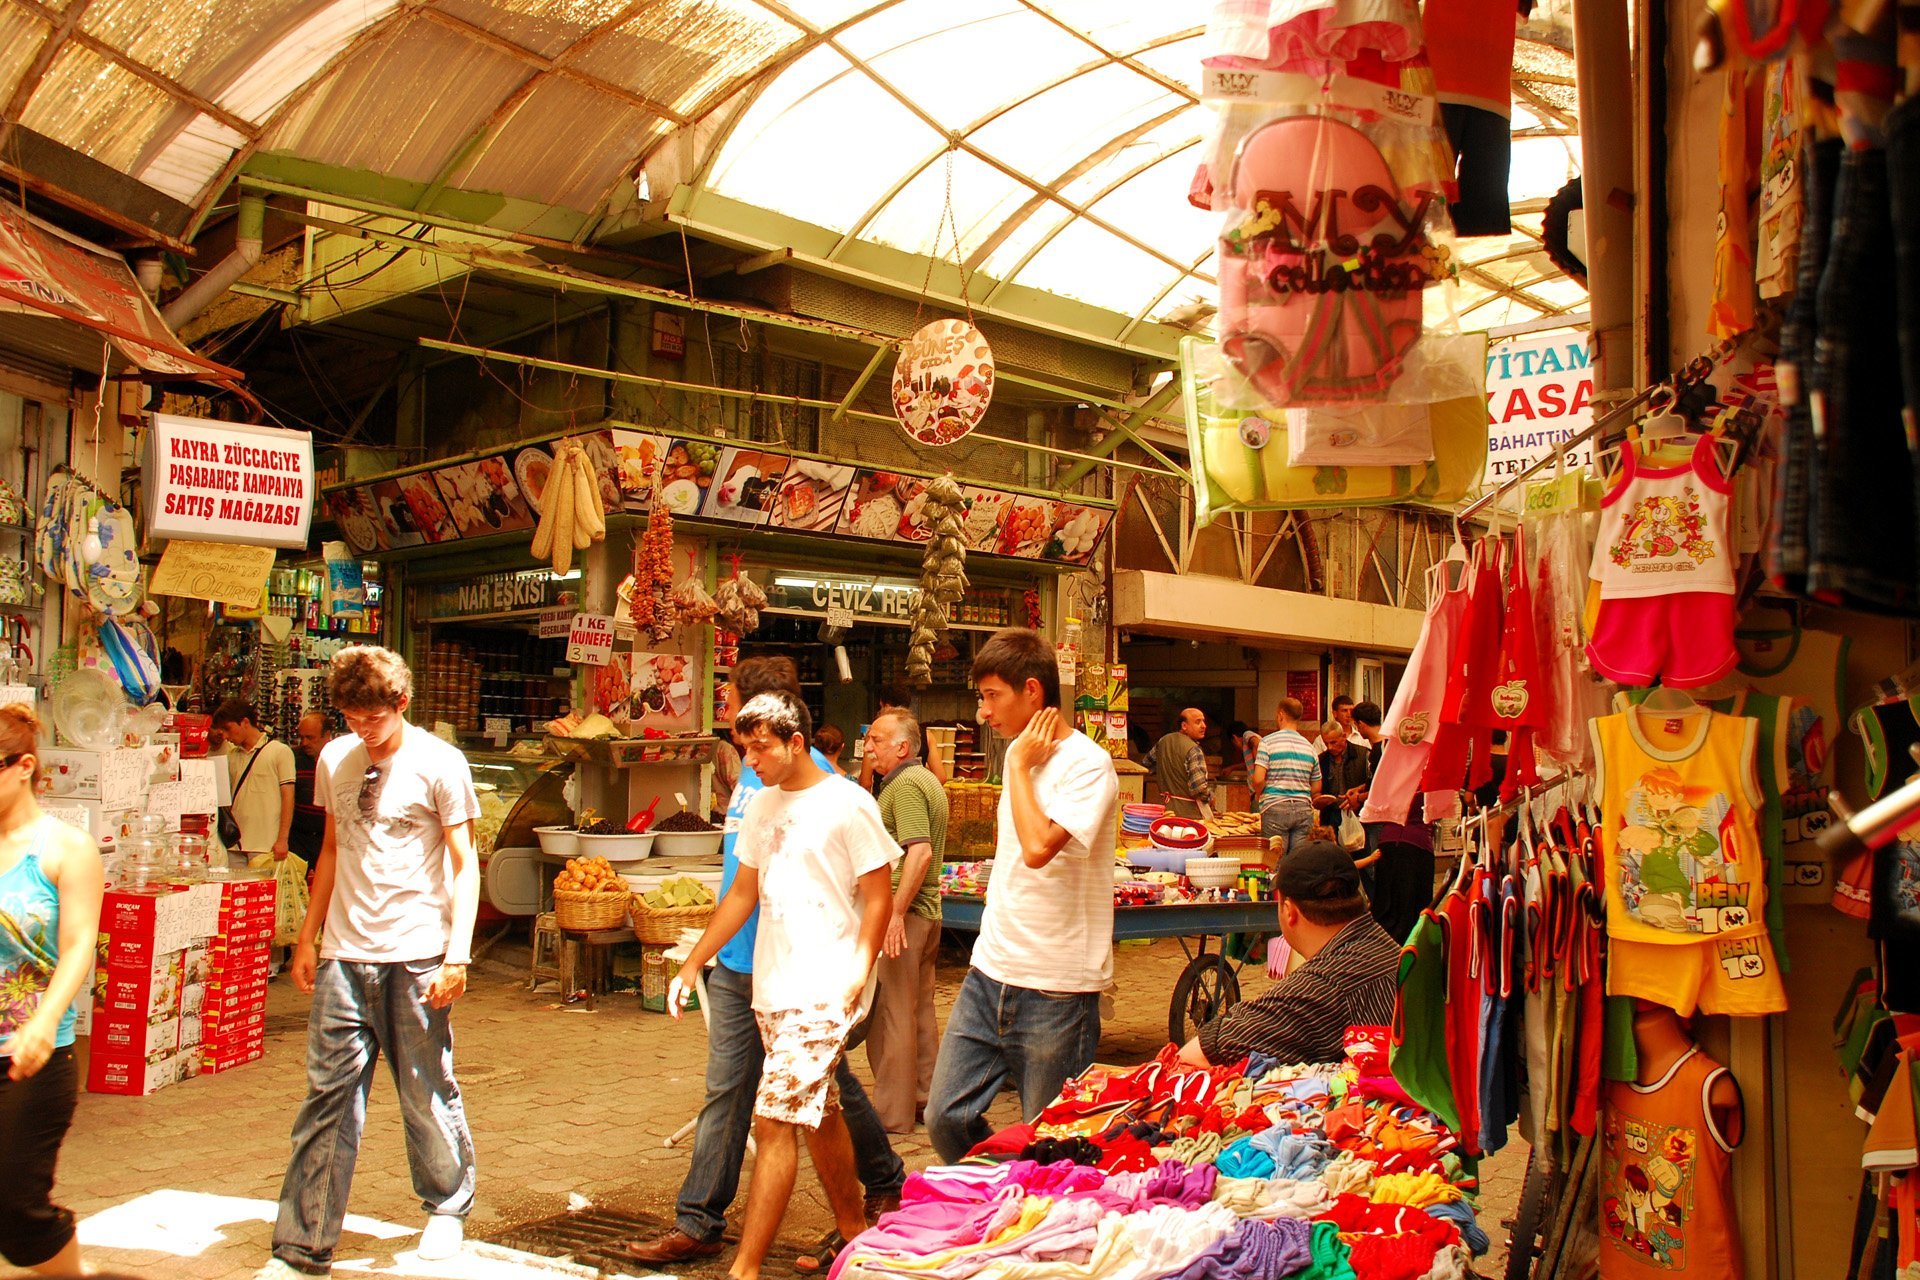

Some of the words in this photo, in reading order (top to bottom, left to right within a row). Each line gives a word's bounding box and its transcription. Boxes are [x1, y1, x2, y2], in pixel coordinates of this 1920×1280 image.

[171, 437, 219, 463] KAYRA
[169, 464, 239, 493] PAŞABAHÇE
[243, 473, 303, 499] KAMPANYA
[165, 493, 214, 520] SATIŞ
[219, 498, 301, 526] MAĞAZASI
[458, 585, 489, 611] NAR
[578, 617, 583, 627] 1
[587, 617, 606, 630] KG
[571, 647, 581, 660] 3
[587, 653, 599, 662] YTL
[1696, 882, 1750, 908] BEN
[1695, 906, 1750, 934] 10
[1720, 954, 1766, 980] 10
[1625, 1120, 1648, 1139] BEN
[1625, 1133, 1648, 1154] 10
